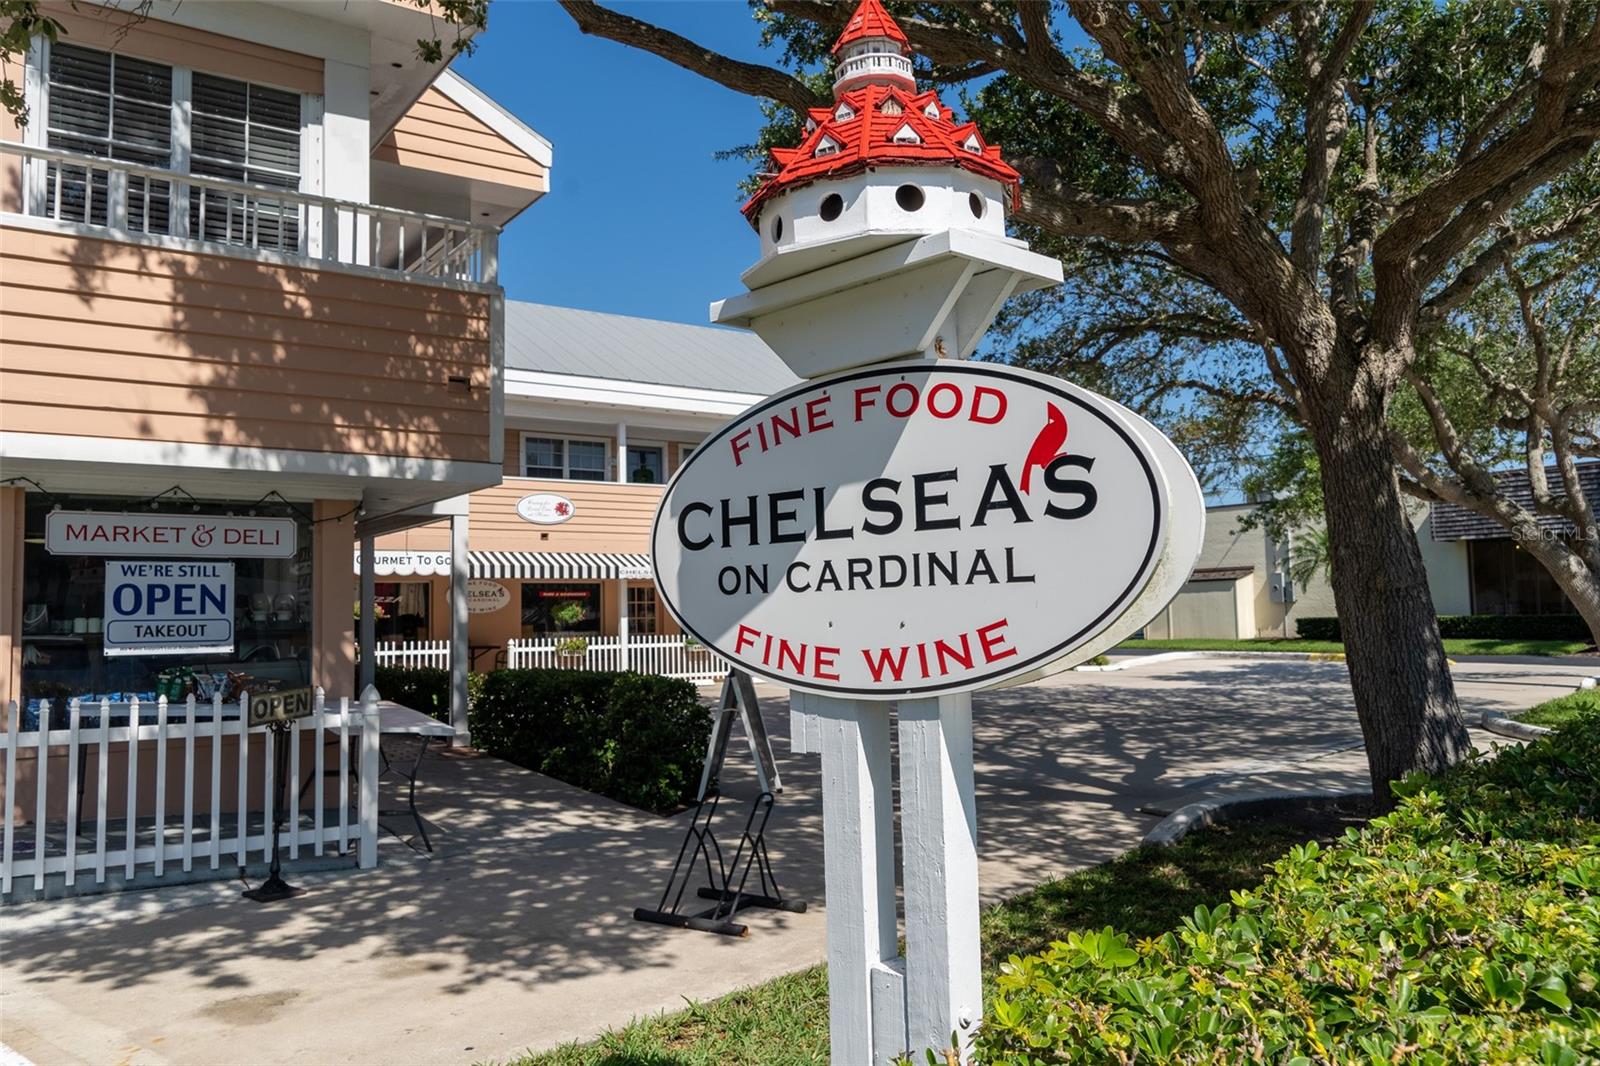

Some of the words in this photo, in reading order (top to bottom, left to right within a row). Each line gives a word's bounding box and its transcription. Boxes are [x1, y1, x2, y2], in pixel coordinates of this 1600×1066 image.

[729, 394, 834, 466] FINE
[853, 382, 1009, 425] FOOD
[66, 524, 187, 543] MARKET
[191, 524, 216, 547] &
[223, 529, 280, 545] DELI
[121, 564, 174, 578] WE'RE
[178, 564, 221, 578] STILL
[717, 564, 769, 596] ON
[785, 547, 1036, 593] CARDINAL
[112, 583, 227, 617] OPEN
[133, 624, 208, 638] TAKEOUT
[733, 624, 841, 682] FINE
[860, 618, 1019, 683] WINE
[254, 692, 309, 720] OPEN
